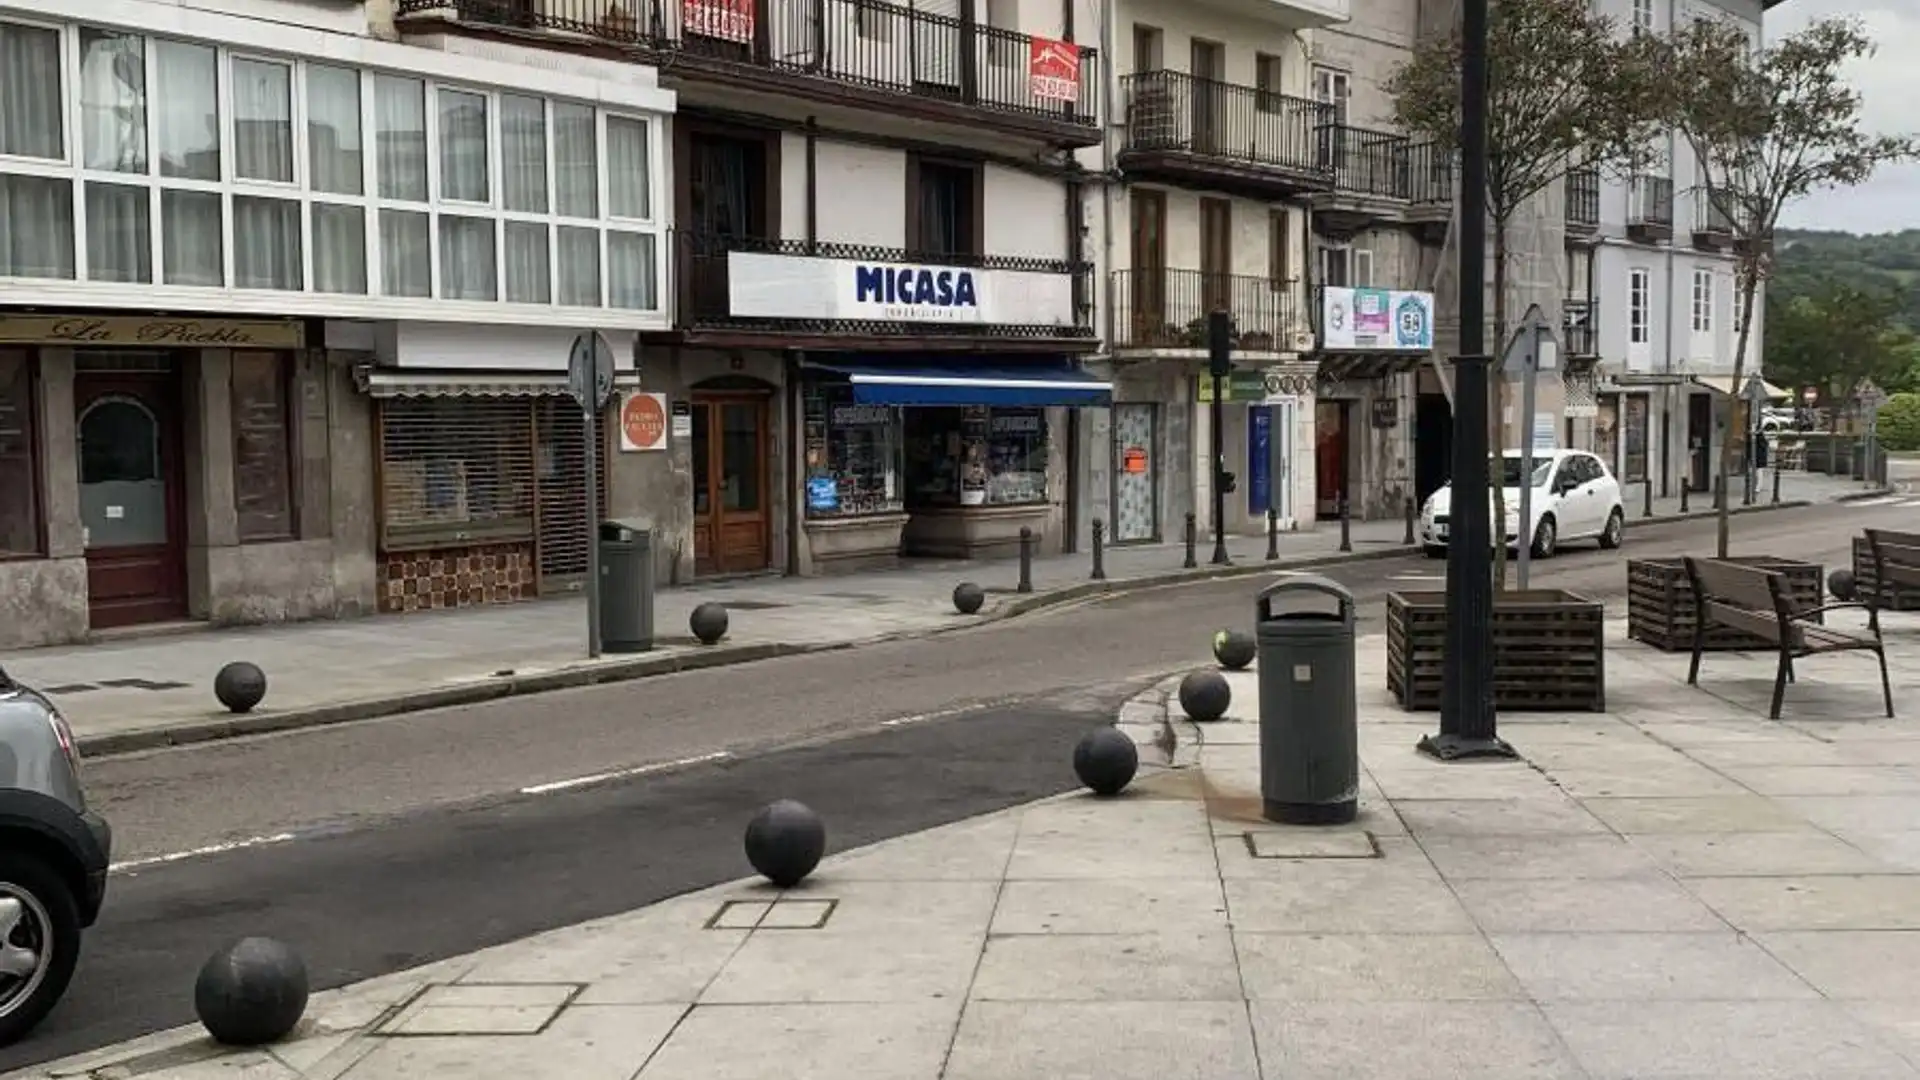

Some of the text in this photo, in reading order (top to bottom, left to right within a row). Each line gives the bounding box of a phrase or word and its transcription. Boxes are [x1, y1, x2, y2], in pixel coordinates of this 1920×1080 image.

[856, 265, 977, 307] MICASA
[46, 318, 256, 344] La Puebla
